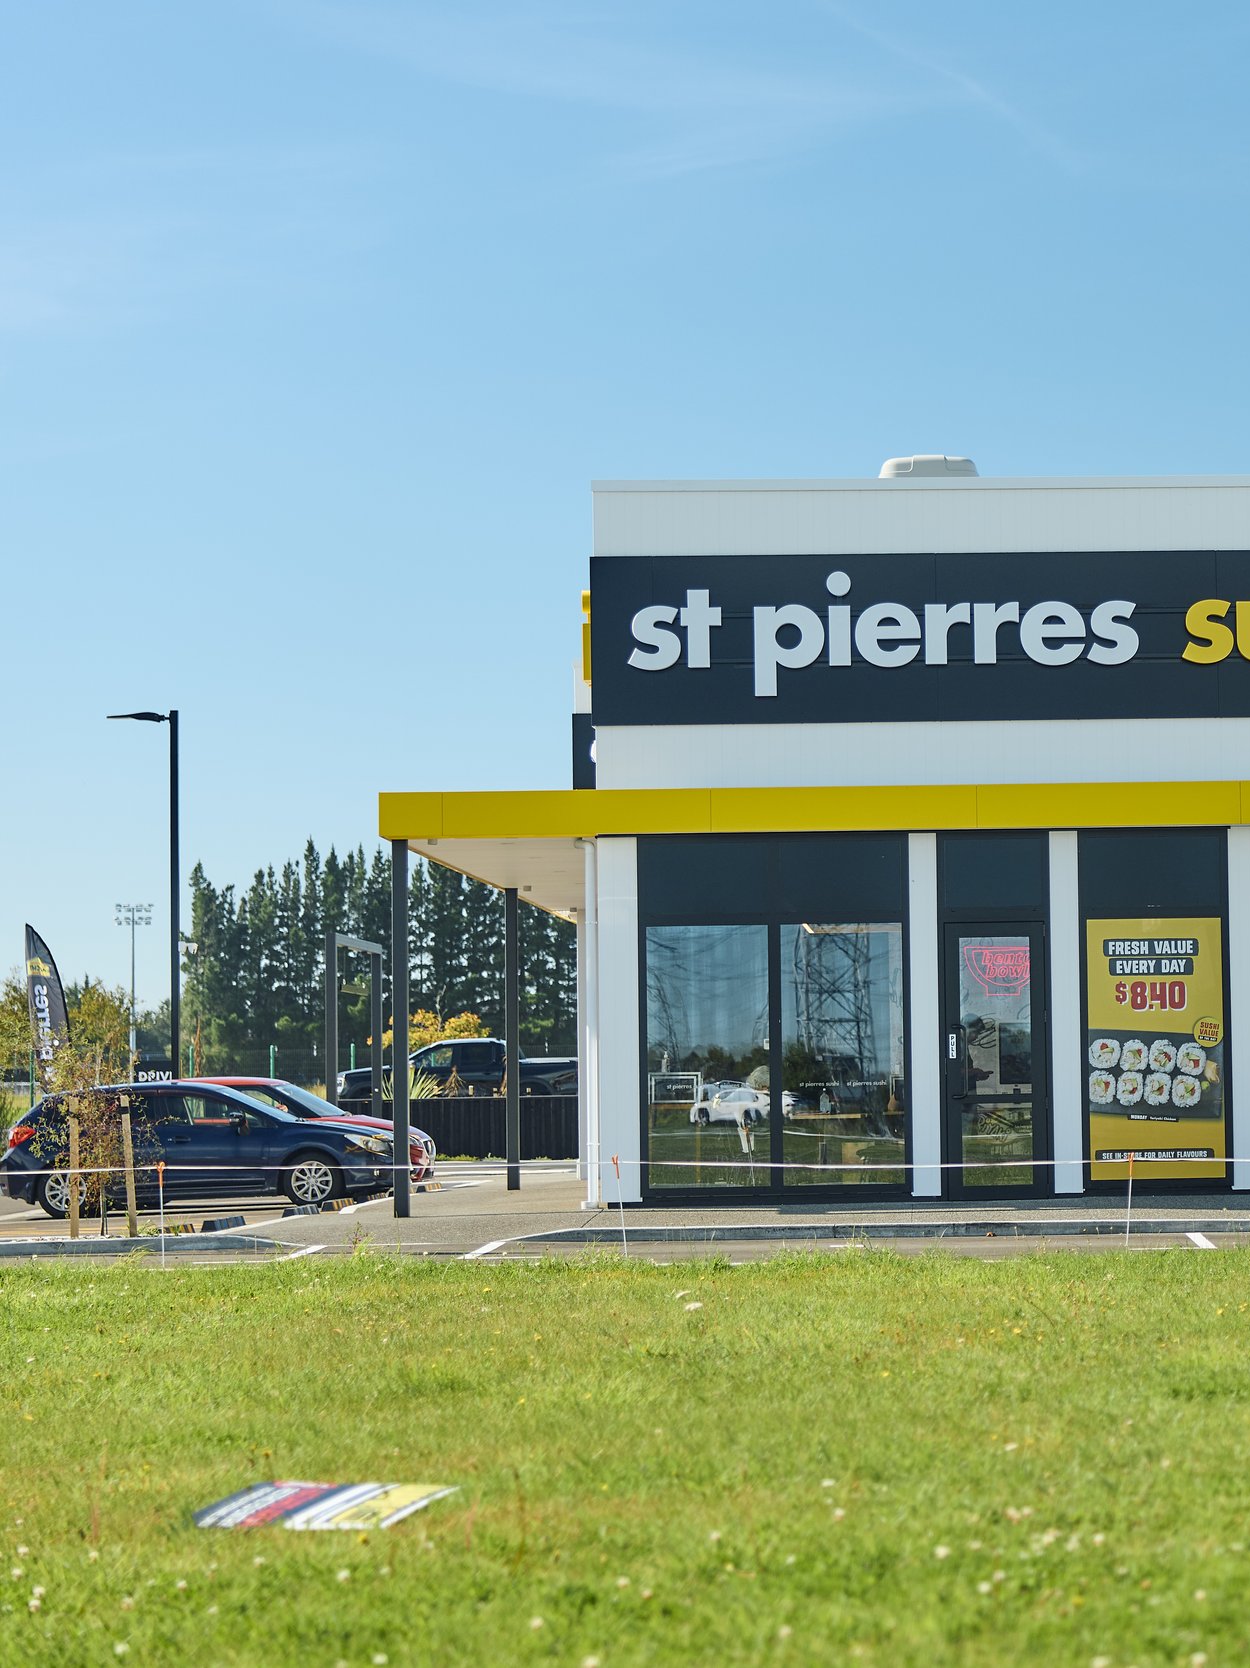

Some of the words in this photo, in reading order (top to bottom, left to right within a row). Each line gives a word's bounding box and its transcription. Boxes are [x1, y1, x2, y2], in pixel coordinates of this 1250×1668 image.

[626, 589, 722, 671] st
[753, 571, 1140, 697] pierres
[1108, 941, 1149, 955] FRESH
[1154, 940, 1194, 954] VALUE
[1116, 960, 1156, 974] EVERY
[1161, 959, 1187, 973] DAY
[1115, 981, 1187, 1011] $8.40
[1200, 1022, 1219, 1030] SUSHI
[1200, 1028, 1218, 1036] VALUE
[138, 1071, 173, 1082] DRIV
[1102, 1152, 1113, 1160] SEE
[1157, 1151, 1175, 1159] DAILY
[1177, 1150, 1208, 1158] FLAVOURS
